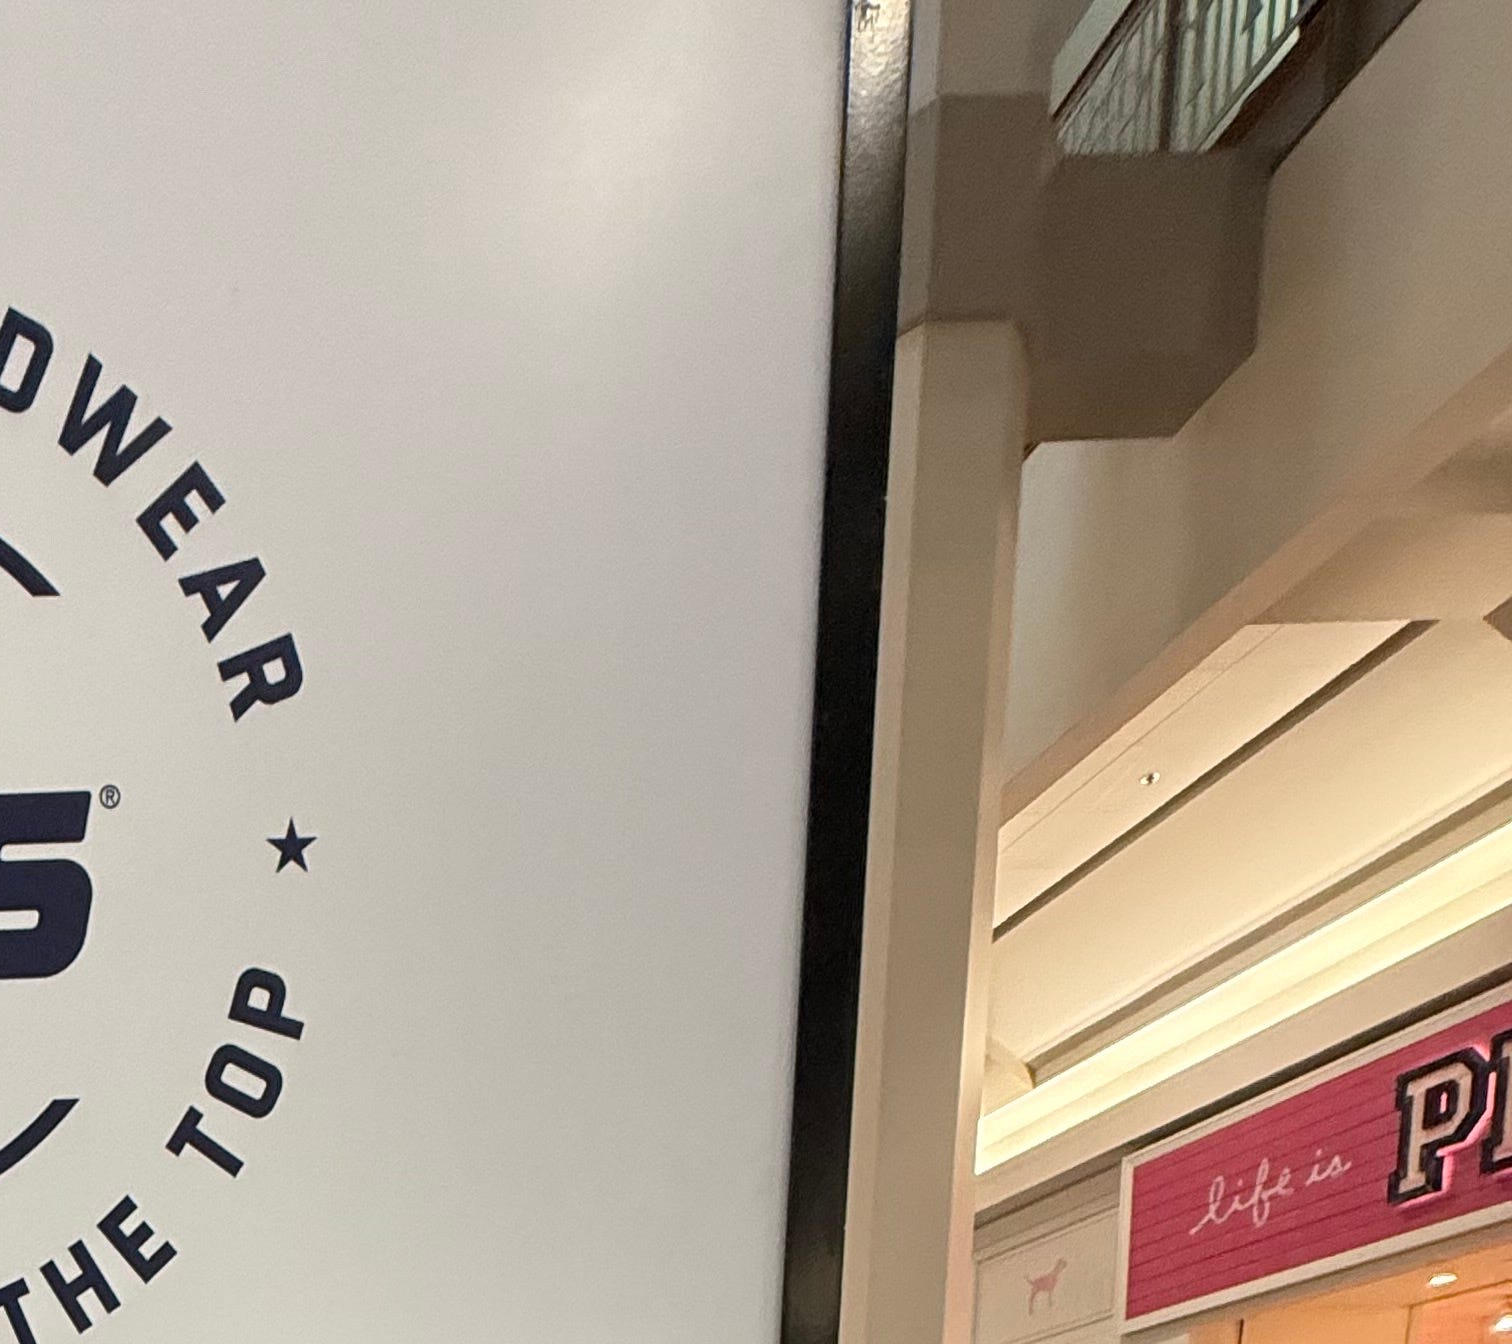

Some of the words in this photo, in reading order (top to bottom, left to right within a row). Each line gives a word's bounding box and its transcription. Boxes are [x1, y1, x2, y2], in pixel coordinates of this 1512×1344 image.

[164, 966, 306, 1179] TOP
[1188, 1157, 1294, 1235] life
[1305, 1148, 1352, 1187] is
